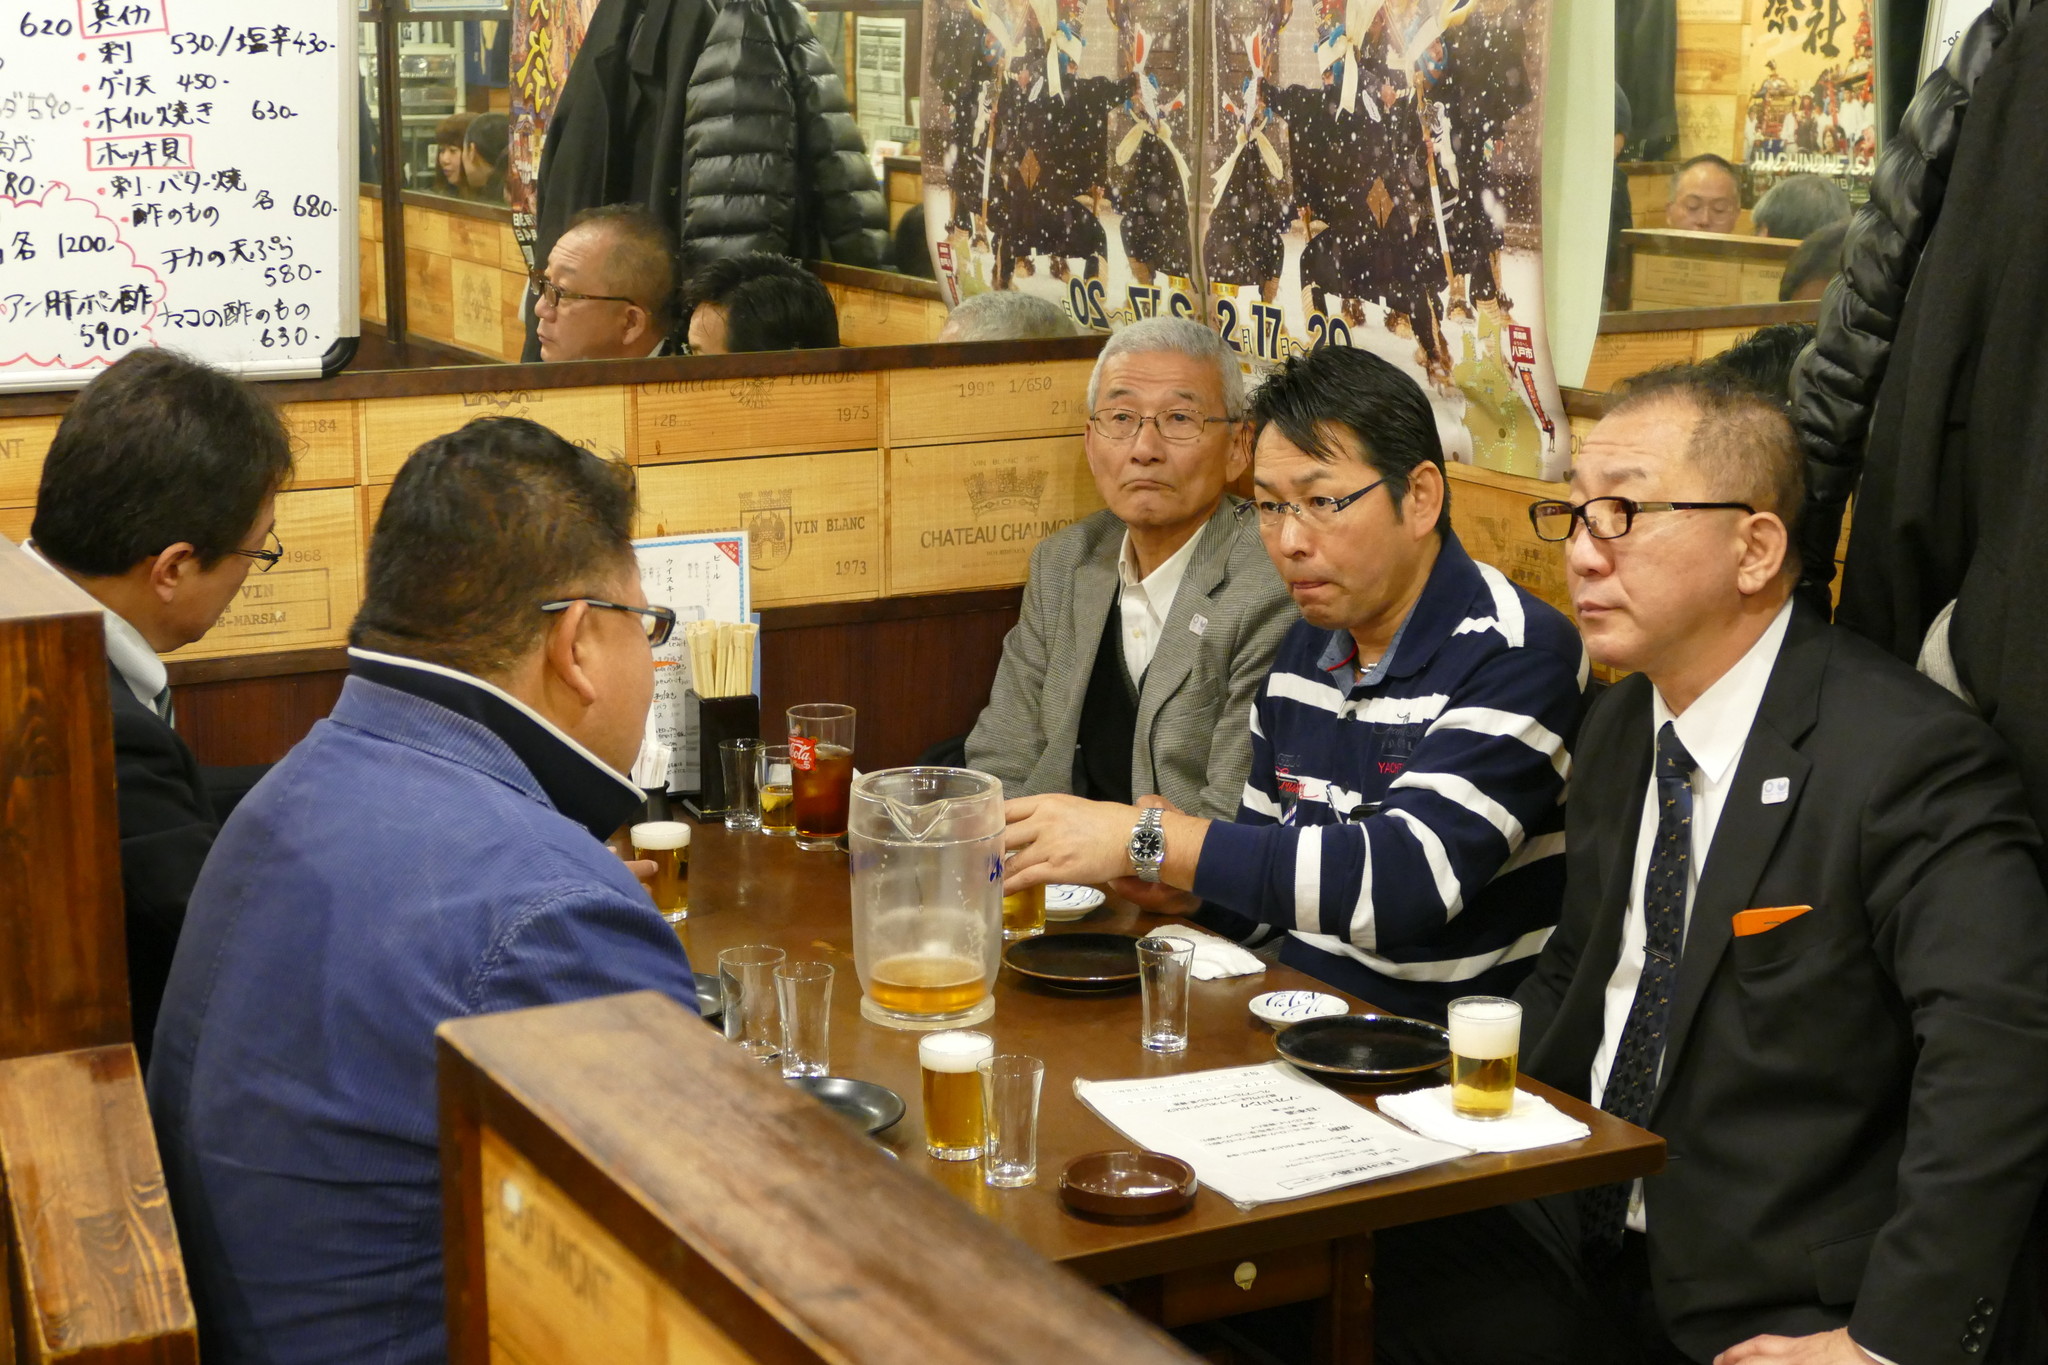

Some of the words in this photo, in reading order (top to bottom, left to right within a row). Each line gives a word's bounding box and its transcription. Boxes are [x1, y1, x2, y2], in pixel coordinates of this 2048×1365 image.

[20, 12, 72, 37] 620
[251, 100, 298, 120] 630-
[96, 137, 187, 167] ホッキ貝
[253, 189, 274, 211] 各
[132, 202, 220, 227] 酢のもの
[12, 231, 36, 261] 各
[161, 235, 294, 274] チカの天ぷら
[157, 298, 311, 328] ナマコの酢のもの
[1512, 345, 1534, 359] 八戸市
[1009, 376, 1053, 394] 1/650
[836, 406, 870, 422] 1975
[300, 419, 337, 434] 1984
[794, 519, 819, 535] VIN
[826, 516, 866, 533] BLANC
[920, 525, 997, 549] CHATEAU
[286, 549, 322, 563] 1968
[713, 554, 721, 580] ビール
[835, 560, 867, 576] 1973
[666, 558, 674, 602] ウイスキー
[241, 584, 275, 599] VIN
